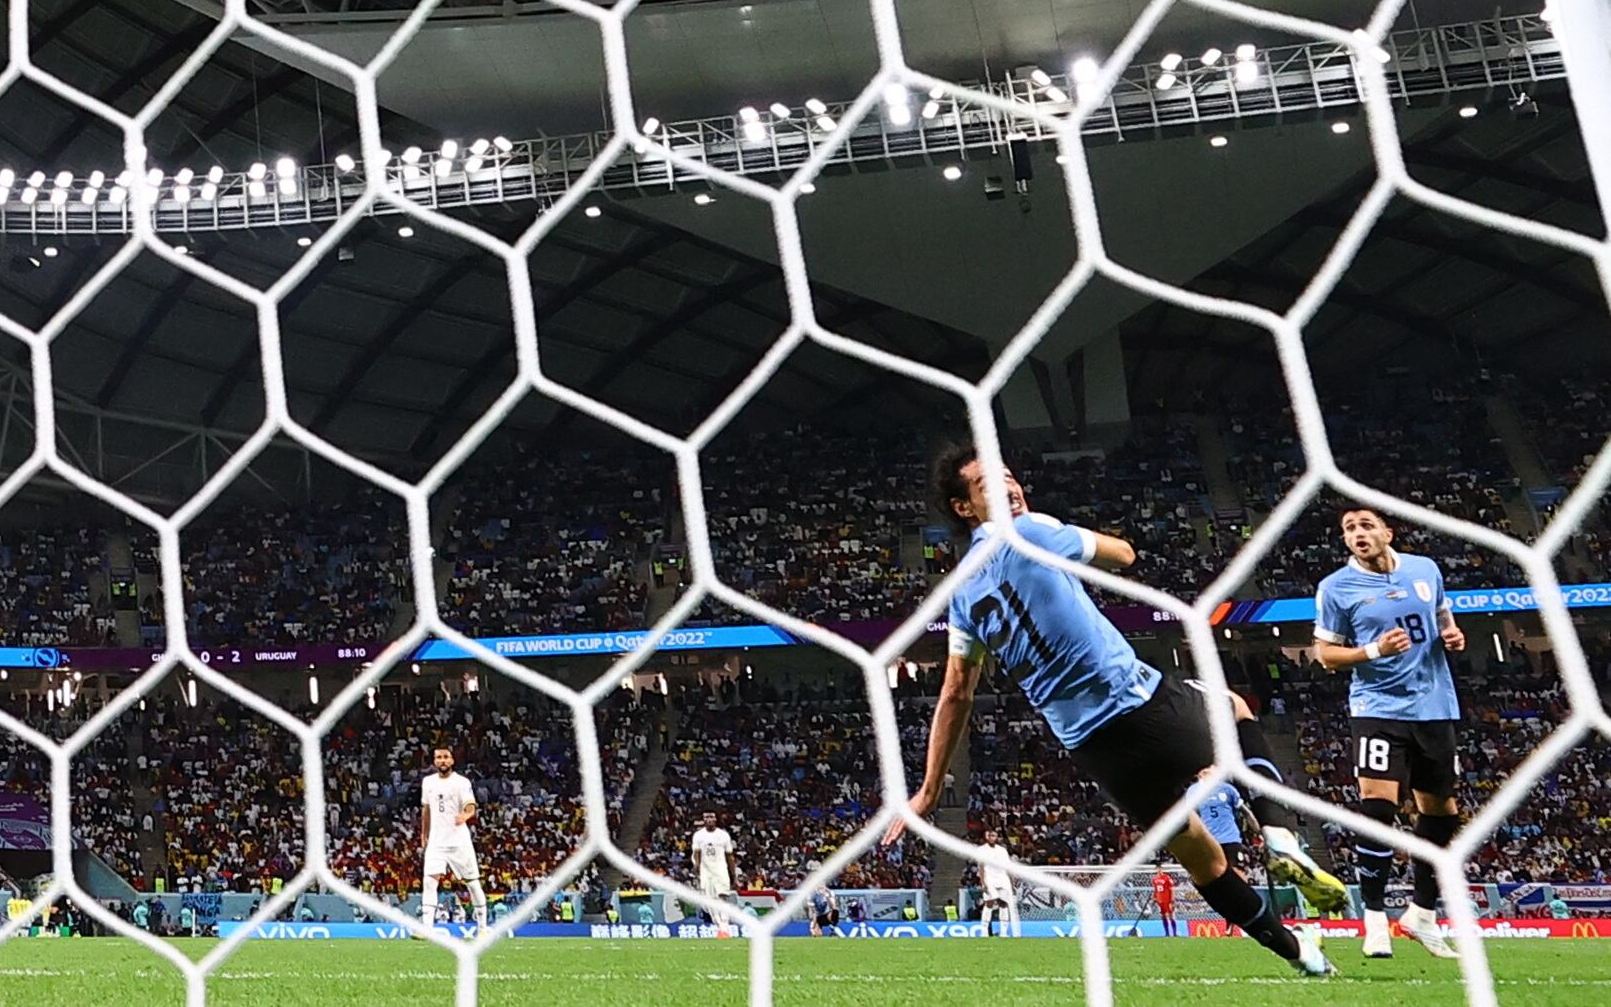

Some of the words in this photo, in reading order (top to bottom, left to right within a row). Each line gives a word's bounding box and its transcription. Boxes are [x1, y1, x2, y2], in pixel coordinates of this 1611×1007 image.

[1455, 594, 1489, 609] CUP
[496, 641, 526, 653] FIFA
[526, 639, 574, 652] WORLD
[575, 637, 602, 650] CUP
[200, 651, 210, 663] 0
[231, 651, 241, 663] 2
[255, 651, 297, 661] URUGUAY
[338, 648, 366, 658] 88:10
[1359, 736, 1390, 772] 18
[1209, 806, 1219, 819] 5
